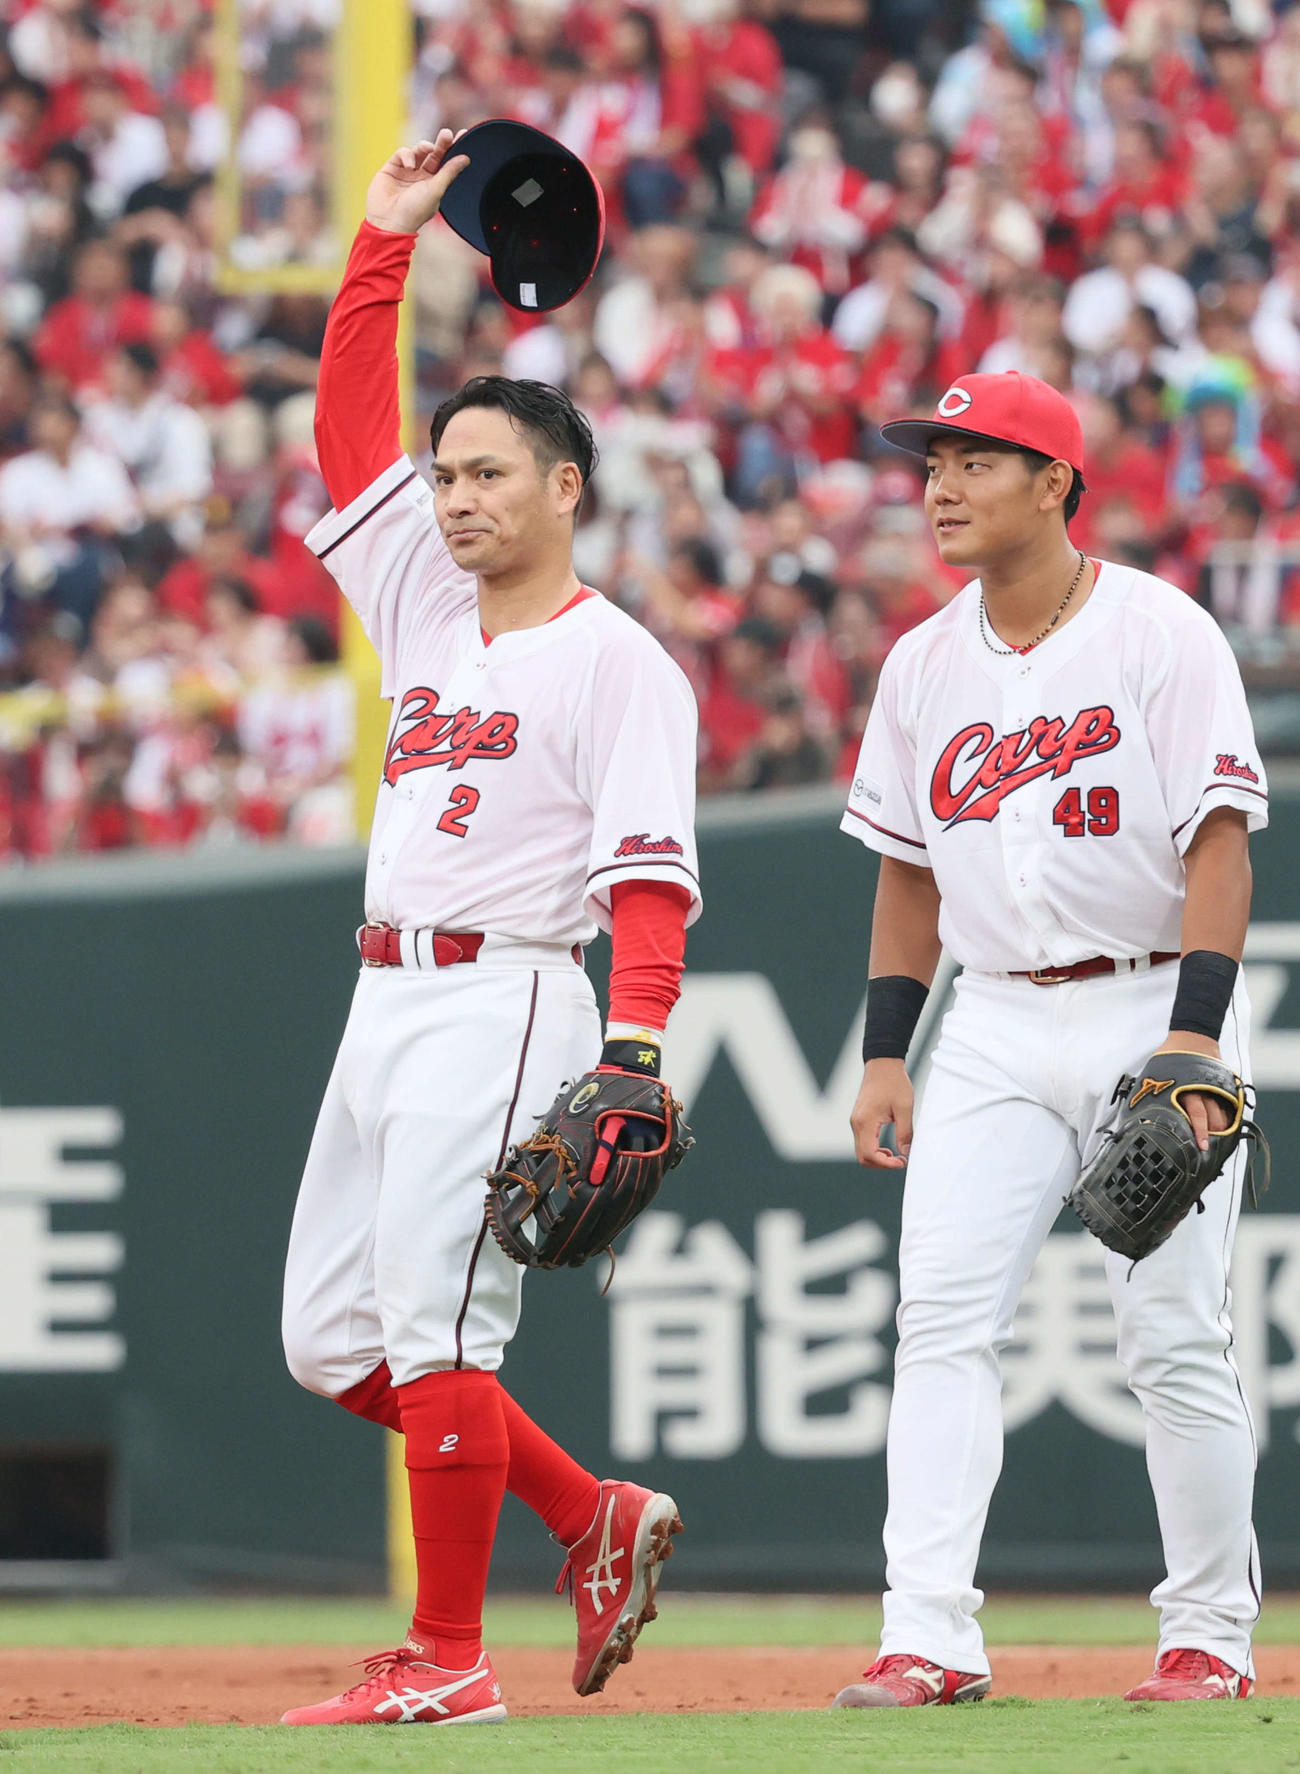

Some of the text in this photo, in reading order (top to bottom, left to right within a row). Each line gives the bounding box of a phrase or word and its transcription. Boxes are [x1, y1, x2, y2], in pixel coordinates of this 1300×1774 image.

[938, 387, 972, 418] C
[382, 686, 519, 788] Carp
[930, 705, 1121, 832] Carp
[436, 784, 480, 838] 2
[1053, 786, 1120, 837] 49
[614, 833, 683, 857] Hiroshim
[439, 1434, 459, 1452] 2
